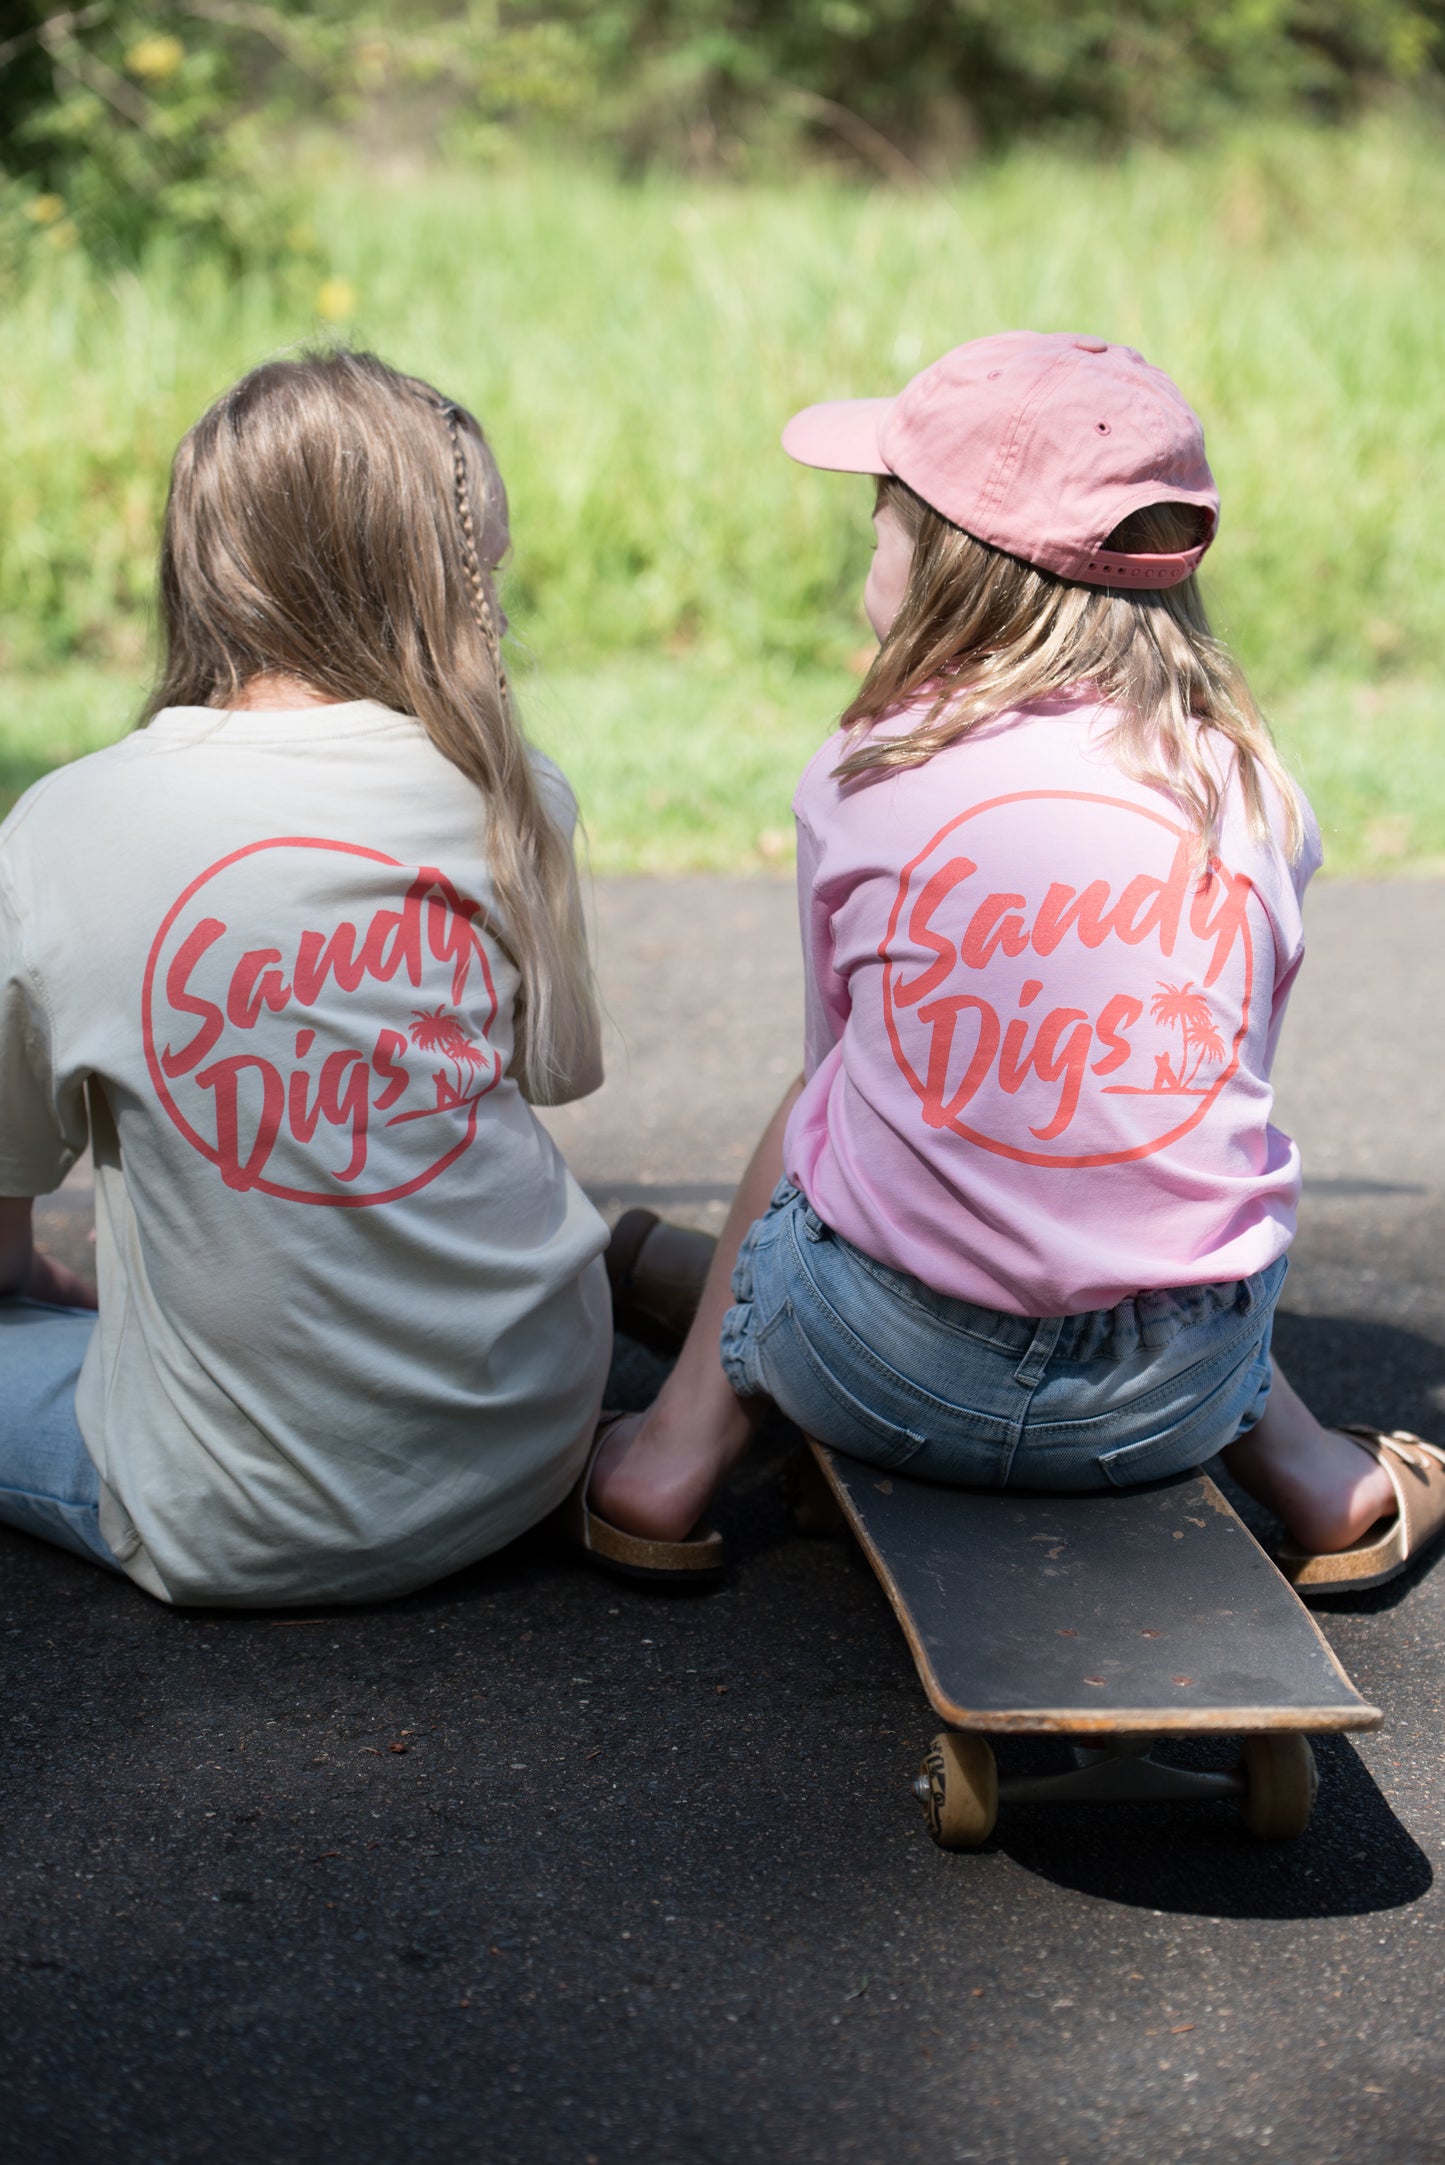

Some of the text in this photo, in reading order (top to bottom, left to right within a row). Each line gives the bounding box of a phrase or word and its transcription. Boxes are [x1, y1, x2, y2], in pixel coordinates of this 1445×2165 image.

[161, 867, 480, 1078] Sandy
[893, 832, 1253, 1008] Sandy
[195, 1029, 409, 1191] Digs
[918, 980, 1143, 1140] Digs
